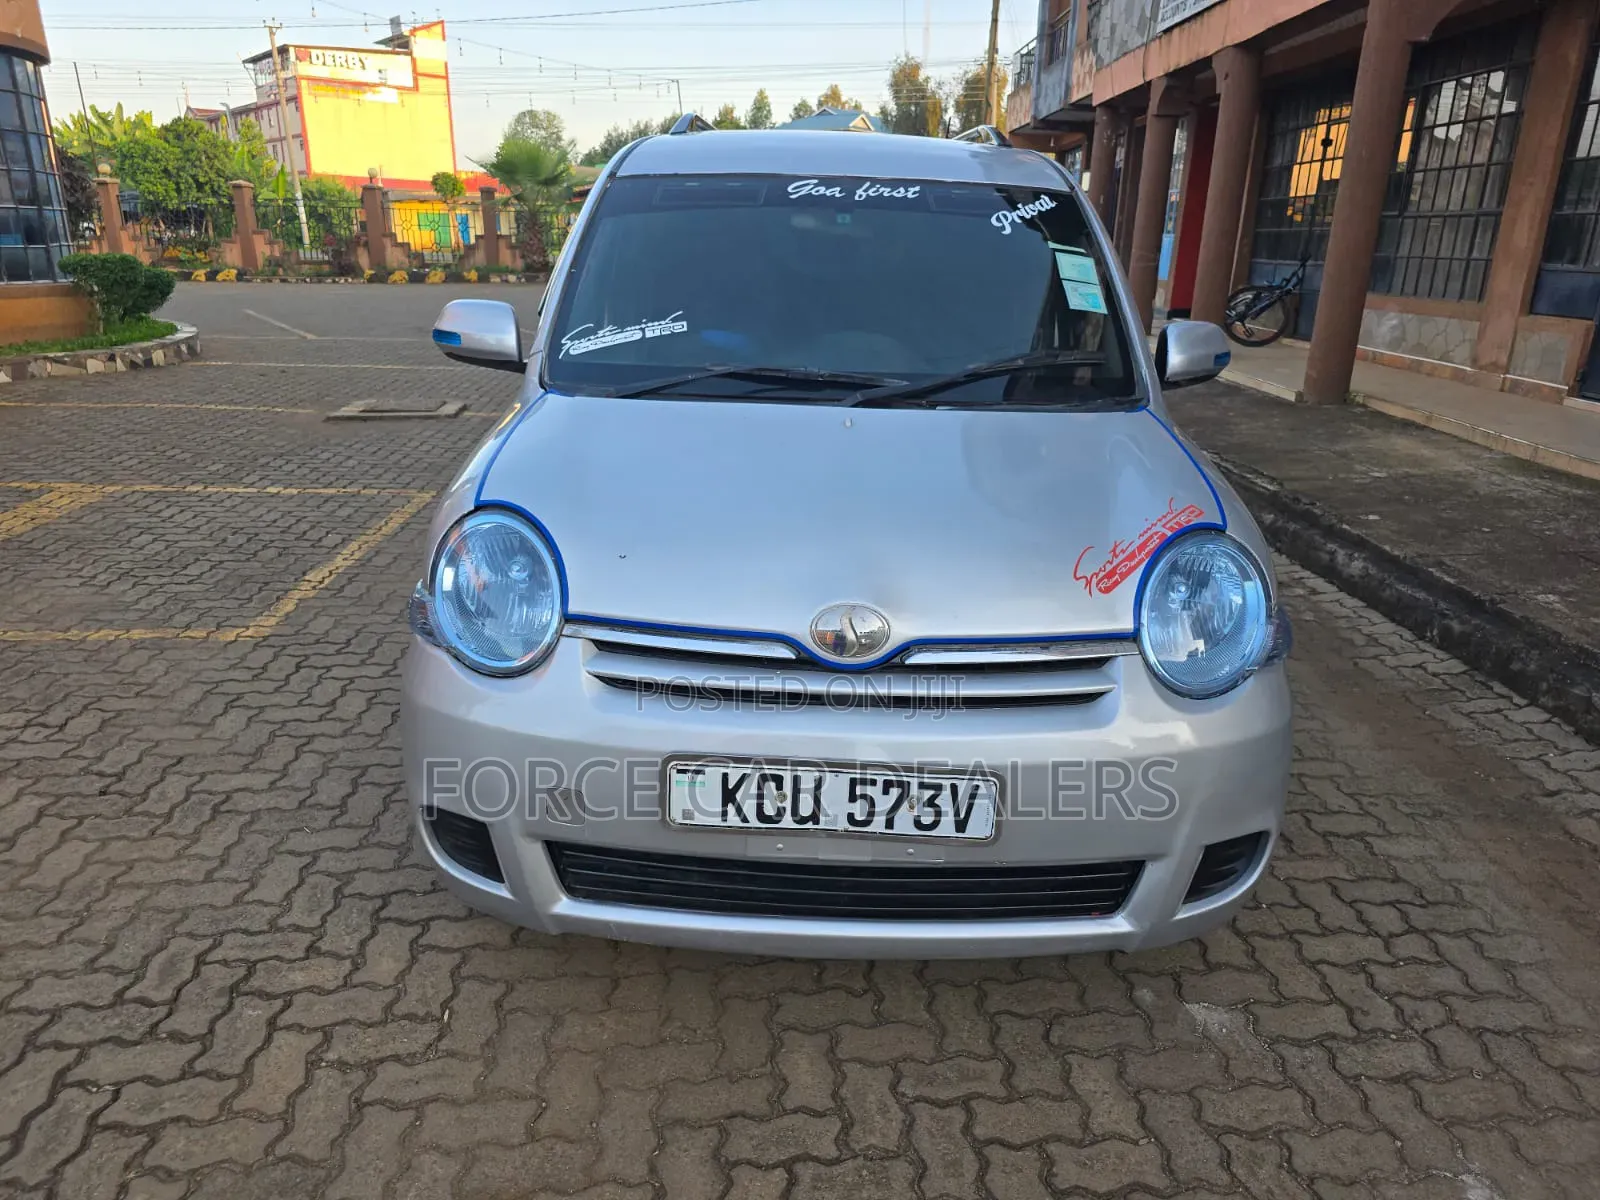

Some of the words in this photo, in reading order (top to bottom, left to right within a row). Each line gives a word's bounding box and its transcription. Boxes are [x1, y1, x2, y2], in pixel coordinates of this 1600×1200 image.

[309, 50, 370, 71] DERBY
[787, 179, 846, 199] Goa
[854, 181, 921, 201] first
[720, 771, 822, 826] KCU
[846, 776, 980, 834] 573V
